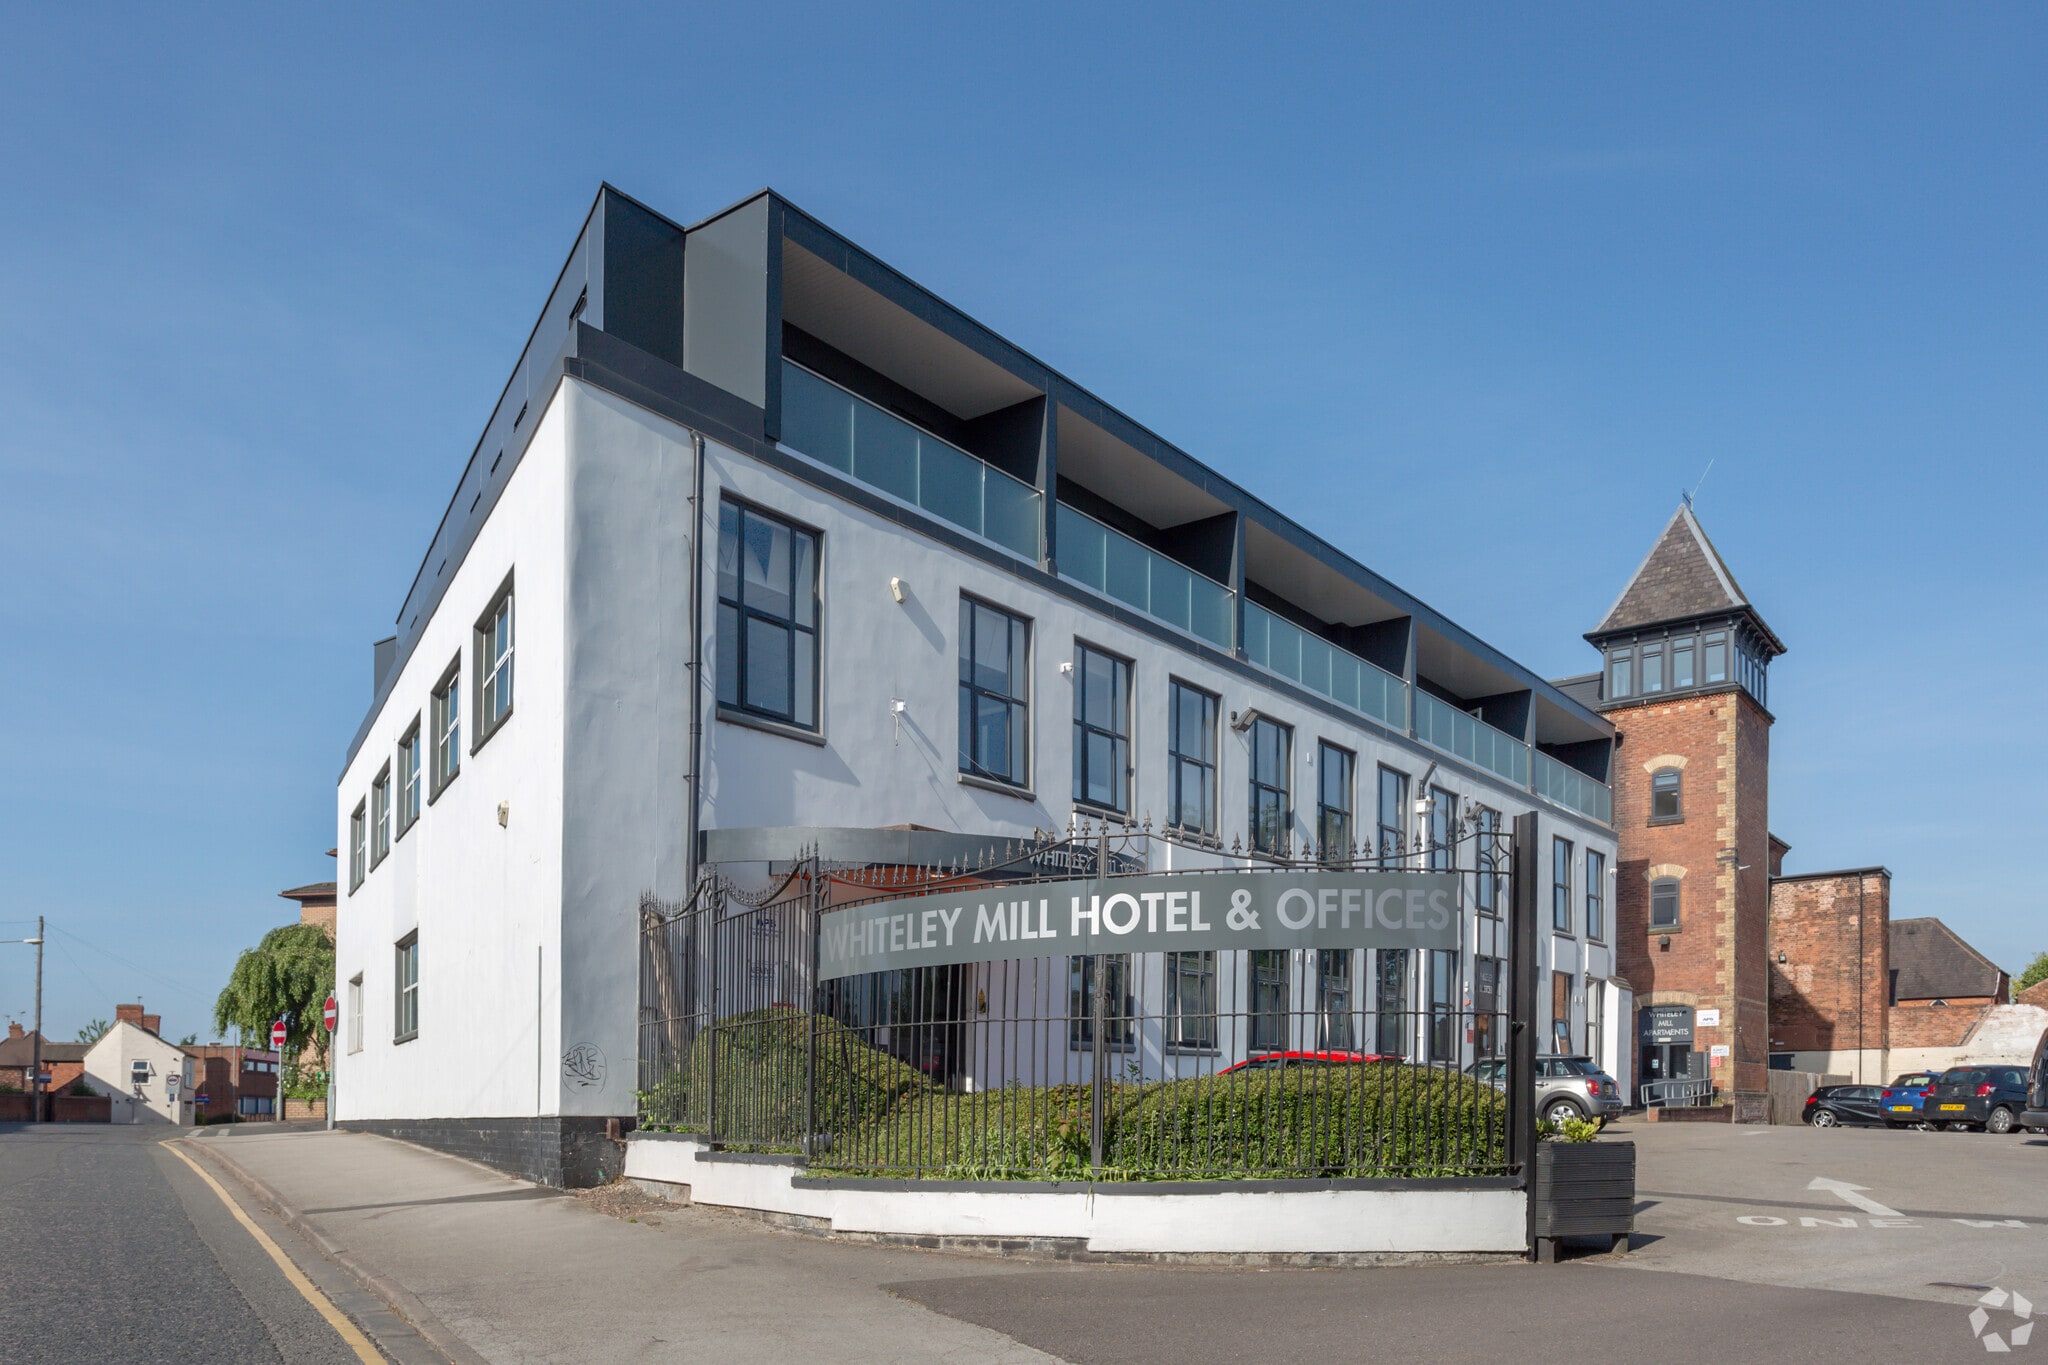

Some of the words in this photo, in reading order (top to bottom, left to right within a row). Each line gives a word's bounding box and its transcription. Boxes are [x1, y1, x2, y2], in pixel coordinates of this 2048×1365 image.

[826, 907, 963, 962] WHITELEY
[973, 899, 1057, 944] MILL
[1071, 890, 1211, 936] HOTEL
[1226, 888, 1262, 931] &
[1276, 888, 1450, 931] OFFICES
[1643, 1028, 1689, 1036] APARTMENTS
[1736, 1215, 1924, 1229] ONE
